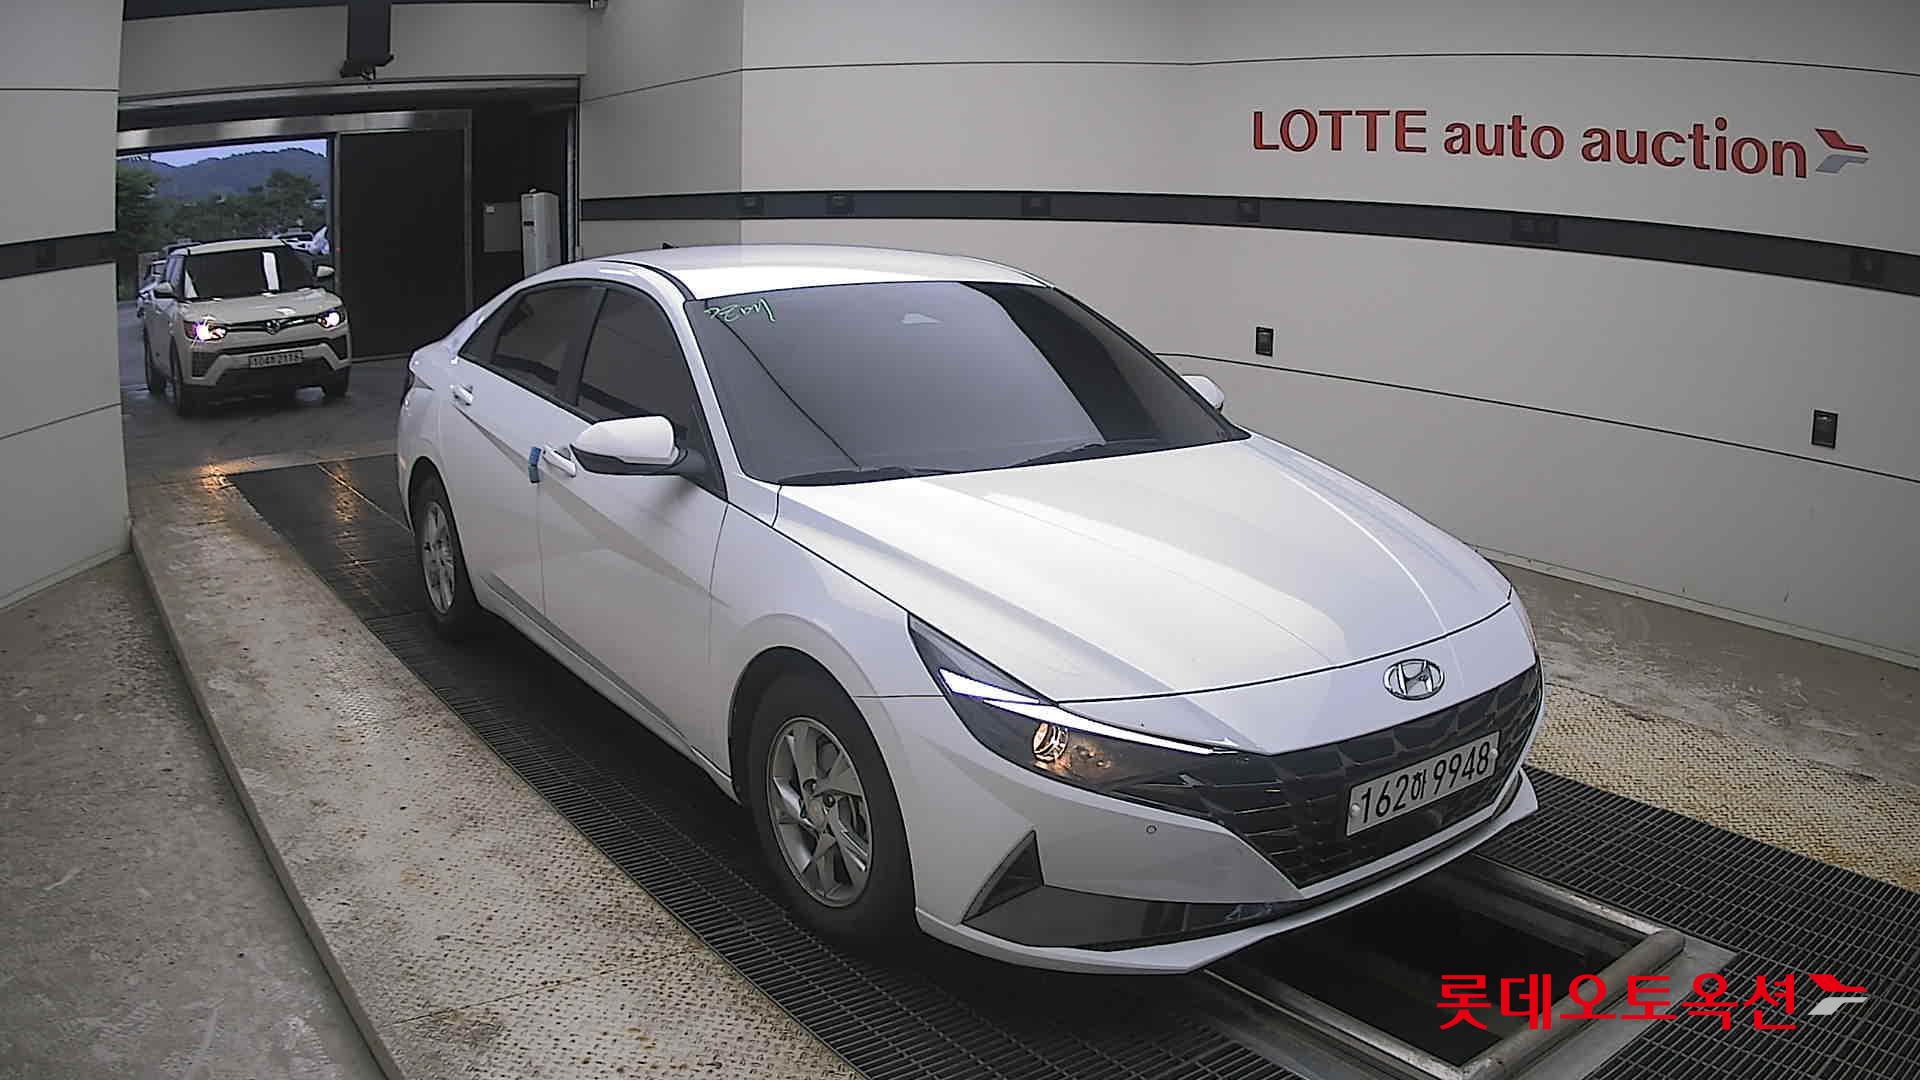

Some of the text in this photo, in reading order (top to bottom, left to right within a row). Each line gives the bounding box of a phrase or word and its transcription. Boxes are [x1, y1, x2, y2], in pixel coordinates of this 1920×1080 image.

[1252, 110, 1808, 179] LOTTE auto auction
[1361, 741, 1491, 823] 162하 9948
